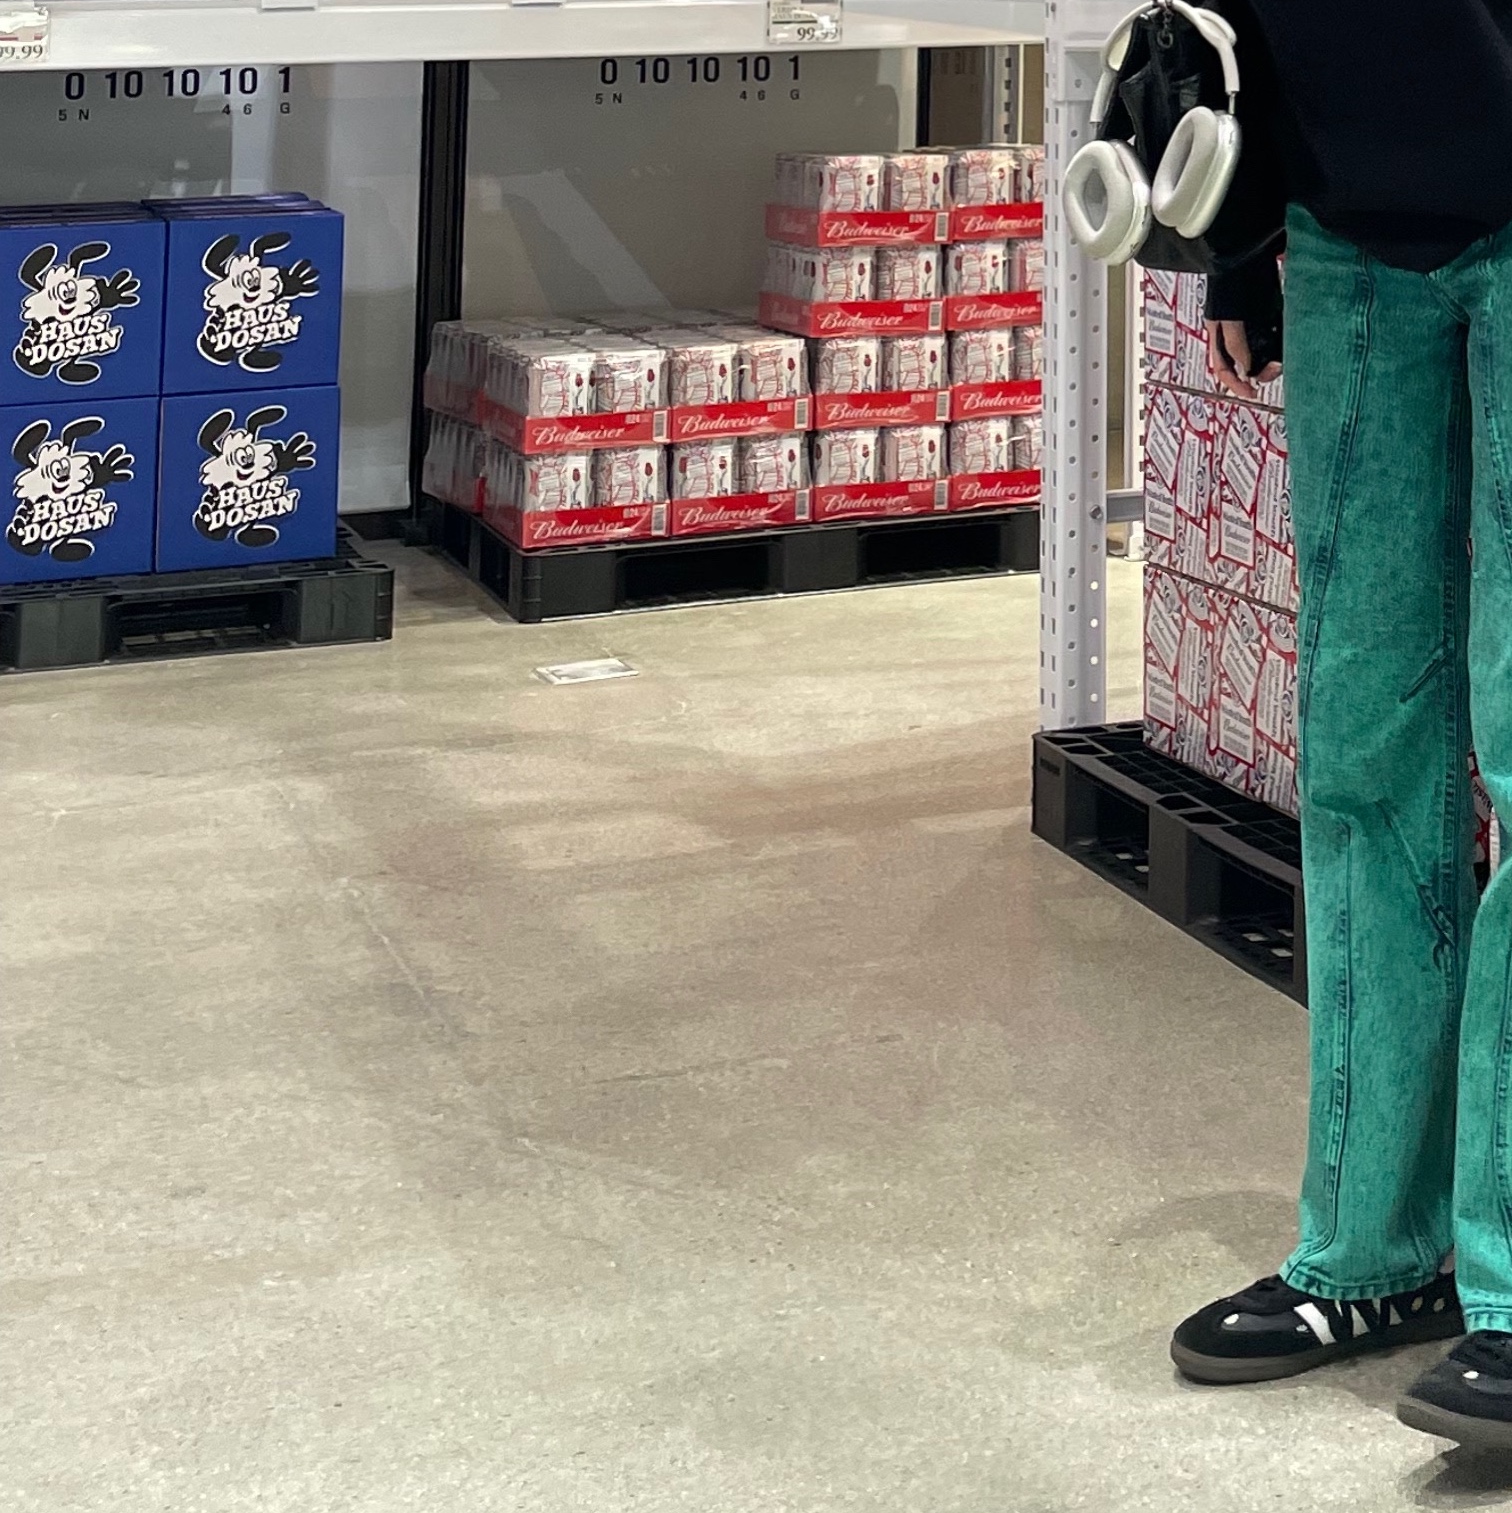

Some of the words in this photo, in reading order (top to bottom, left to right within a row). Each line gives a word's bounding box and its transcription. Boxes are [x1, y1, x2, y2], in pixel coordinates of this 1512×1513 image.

[634, 58, 670, 84] 10
[686, 56, 721, 83] 10
[737, 55, 771, 81] 10
[788, 54, 800, 80] 1
[105, 71, 144, 99] 10
[163, 69, 200, 96] 10
[220, 67, 258, 95] 10
[278, 66, 291, 93] 1
[78, 109, 90, 120] N
[222, 104, 231, 115] 4
[243, 104, 252, 115] 6
[824, 220, 909, 238] Budweiser
[224, 303, 290, 329] HAUS
[817, 311, 903, 330] Budweiser
[955, 302, 1036, 322] Budweiser
[40, 314, 108, 340] HAUS
[211, 316, 302, 352] DOSAN
[26, 329, 121, 366] DOSAN
[678, 407, 769, 433] Budweiser
[825, 401, 910, 421] Budweiser
[533, 424, 625, 447] Budweiser
[217, 479, 285, 507] HAUS
[824, 491, 909, 512] Budweiser
[33, 492, 102, 522] HAUS
[205, 493, 297, 530] DOSAN
[19, 506, 115, 545] DOSAN
[530, 518, 624, 541] Budweiser
